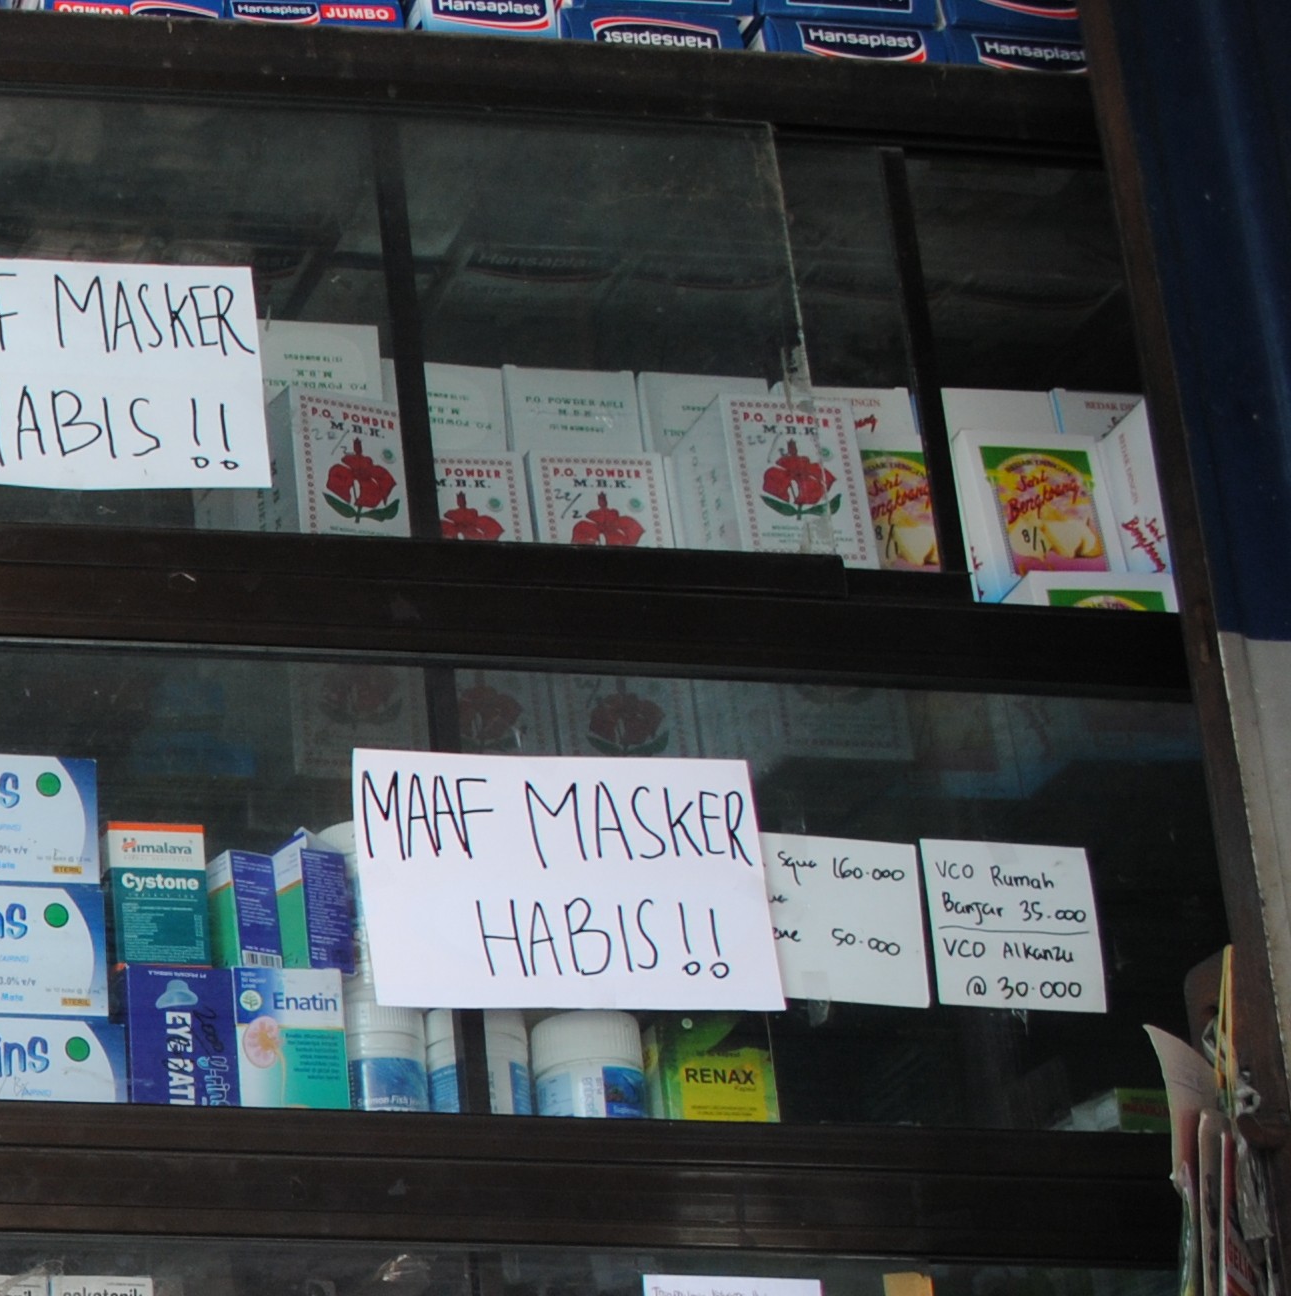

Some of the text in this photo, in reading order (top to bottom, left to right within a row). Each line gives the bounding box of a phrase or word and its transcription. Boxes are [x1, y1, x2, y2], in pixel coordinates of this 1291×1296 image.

[237, 3, 312, 16] Hansaplast
[326, 7, 389, 21] JUMBO
[810, 29, 915, 50] Hansaplast
[54, 273, 255, 356] MASKER
[342, 411, 395, 432] POWDER
[360, 768, 754, 868] MAAF MASKER
[121, 873, 199, 891] Cystone
[936, 861, 1054, 889] VCO Rumah
[942, 938, 986, 958] VCO
[273, 992, 338, 1012] Enatin
[684, 1067, 755, 1087] RENAX
